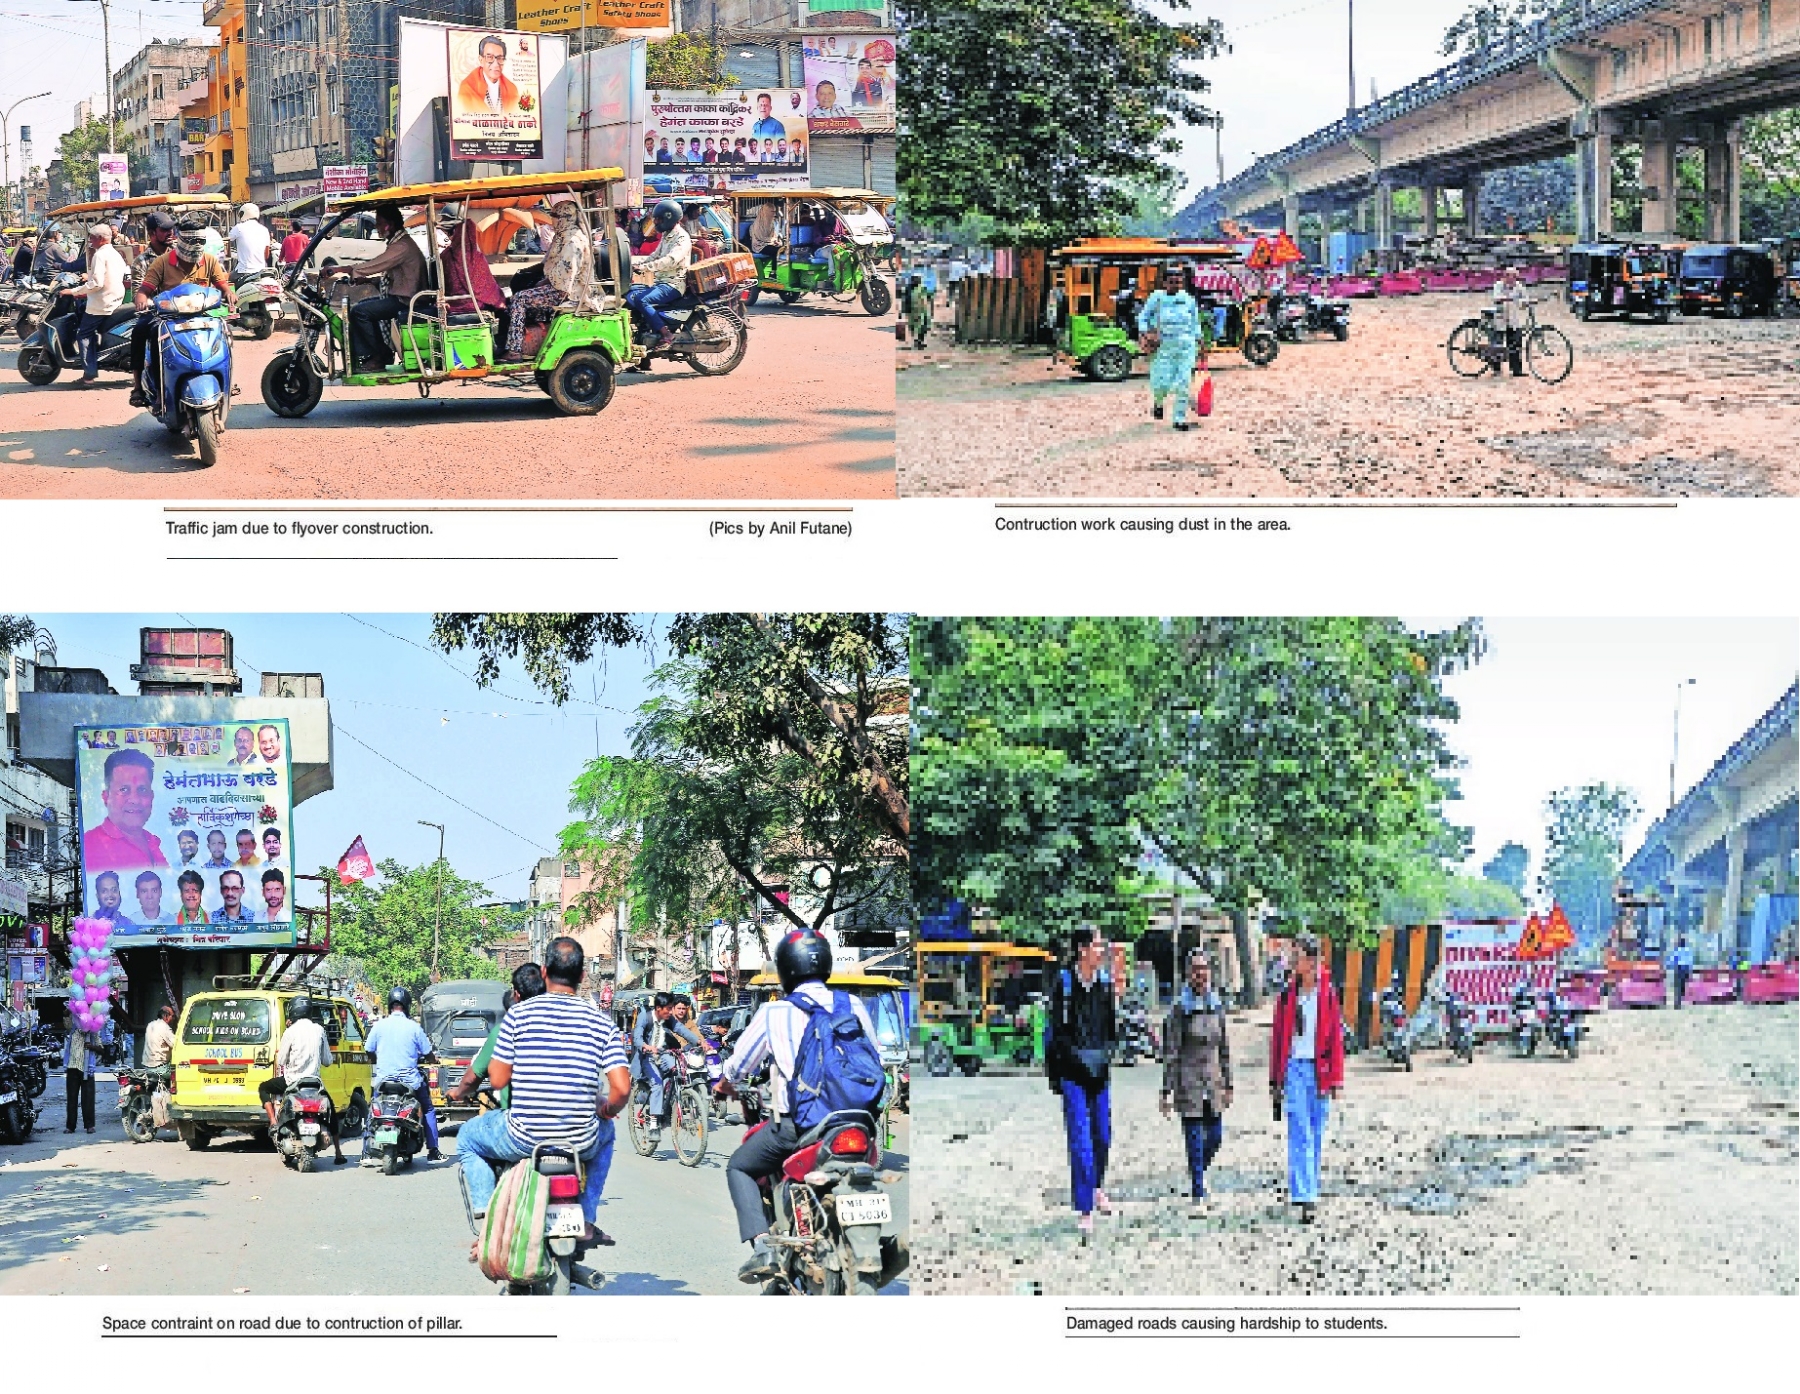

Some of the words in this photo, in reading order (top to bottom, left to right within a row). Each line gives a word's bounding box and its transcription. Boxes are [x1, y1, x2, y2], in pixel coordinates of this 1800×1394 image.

[518, 8, 560, 20] Leather
[603, 9, 632, 18] Safety
[189, 133, 205, 142] BAR
[230, 1011, 246, 1020] SLOW
[192, 1026, 213, 1035] SCHOOL
[230, 1026, 239, 1035] ON
[205, 1047, 228, 1058] SCHOOL
[230, 1047, 243, 1058] BUS
[541, 1155, 568, 1165] YAMAHA
[846, 1199, 863, 1207] MH
